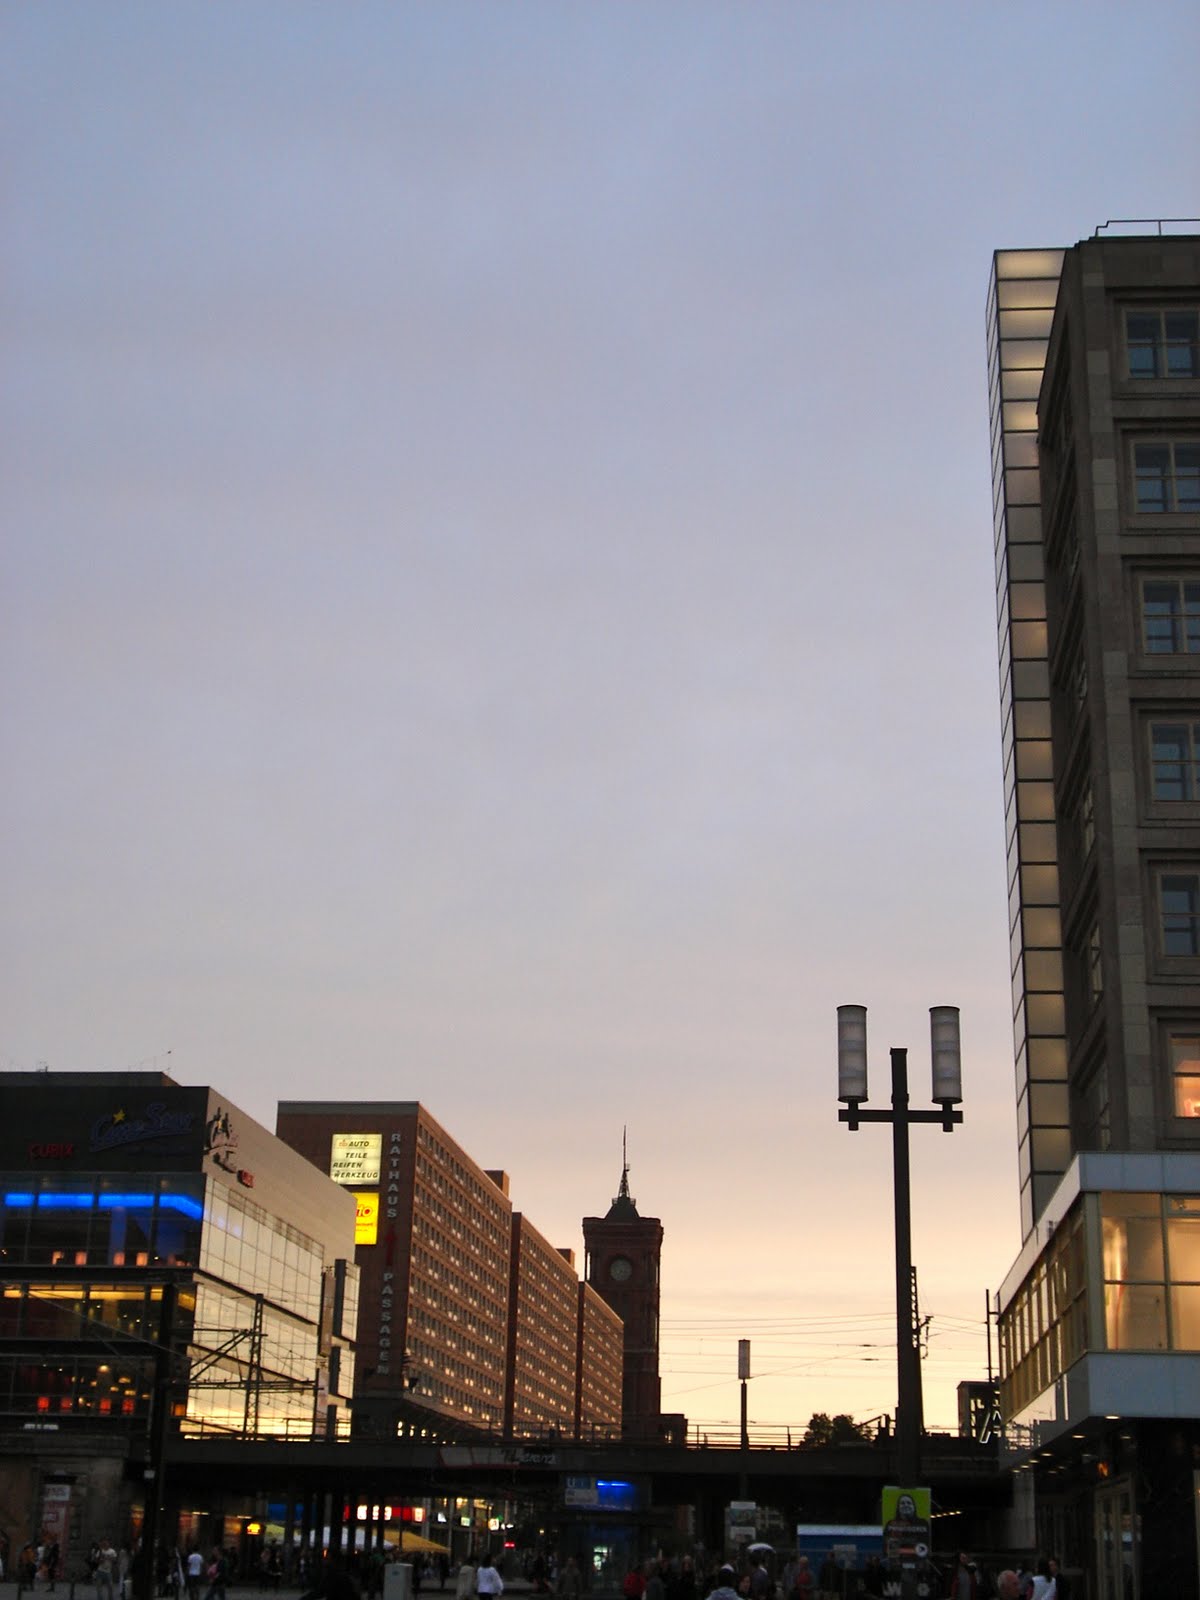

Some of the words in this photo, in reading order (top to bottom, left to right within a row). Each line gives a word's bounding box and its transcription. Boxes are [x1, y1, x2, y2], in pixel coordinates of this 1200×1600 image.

[334, 1171, 378, 1179] WERKZEUG
[387, 1133, 401, 1218] RATHAUS
[377, 1272, 395, 1374] PASSAGEN
